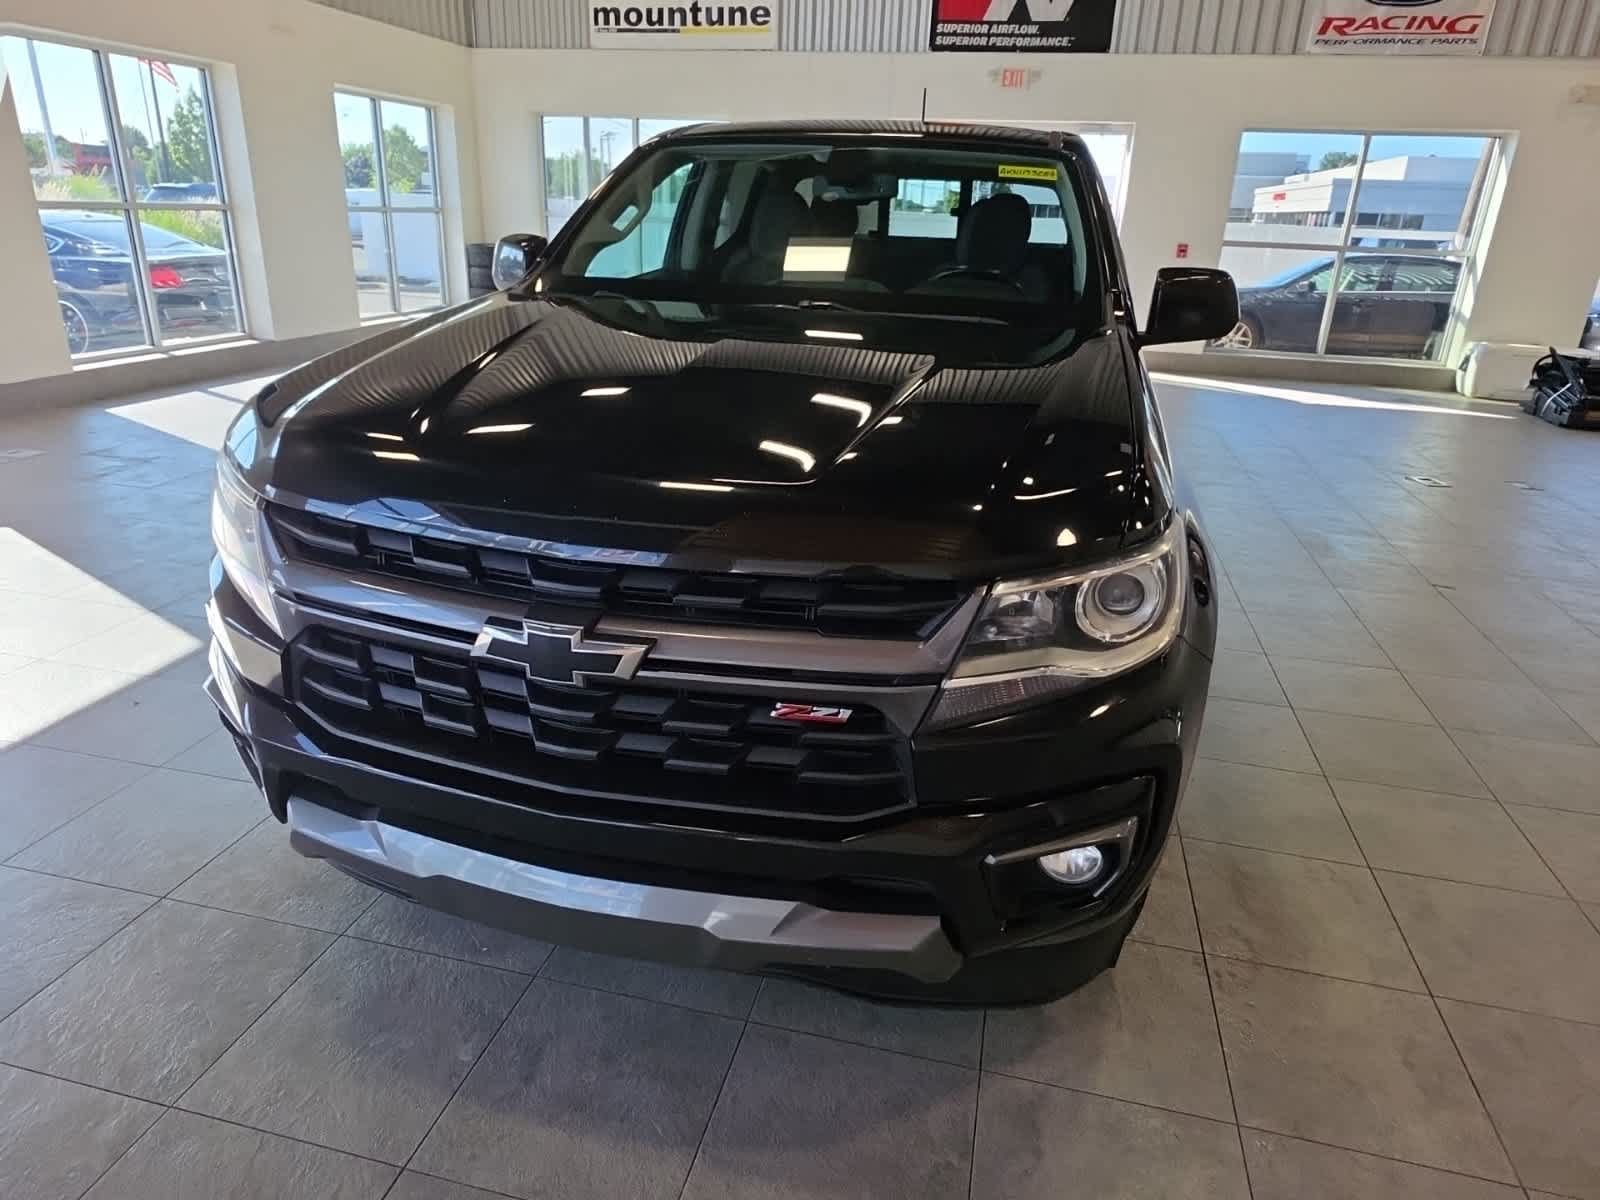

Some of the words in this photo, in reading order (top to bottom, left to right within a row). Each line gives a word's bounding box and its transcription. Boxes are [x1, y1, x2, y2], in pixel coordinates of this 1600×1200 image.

[593, 1, 771, 27] mountune
[936, 23, 989, 34] SUPERIOR
[990, 24, 1040, 35] AIRFLOW.
[1317, 15, 1485, 36] RACING
[935, 36, 988, 46] SUPERIOR
[1314, 38, 1426, 46] PERFORMANCE
[1002, 69, 1025, 88] EXIT
